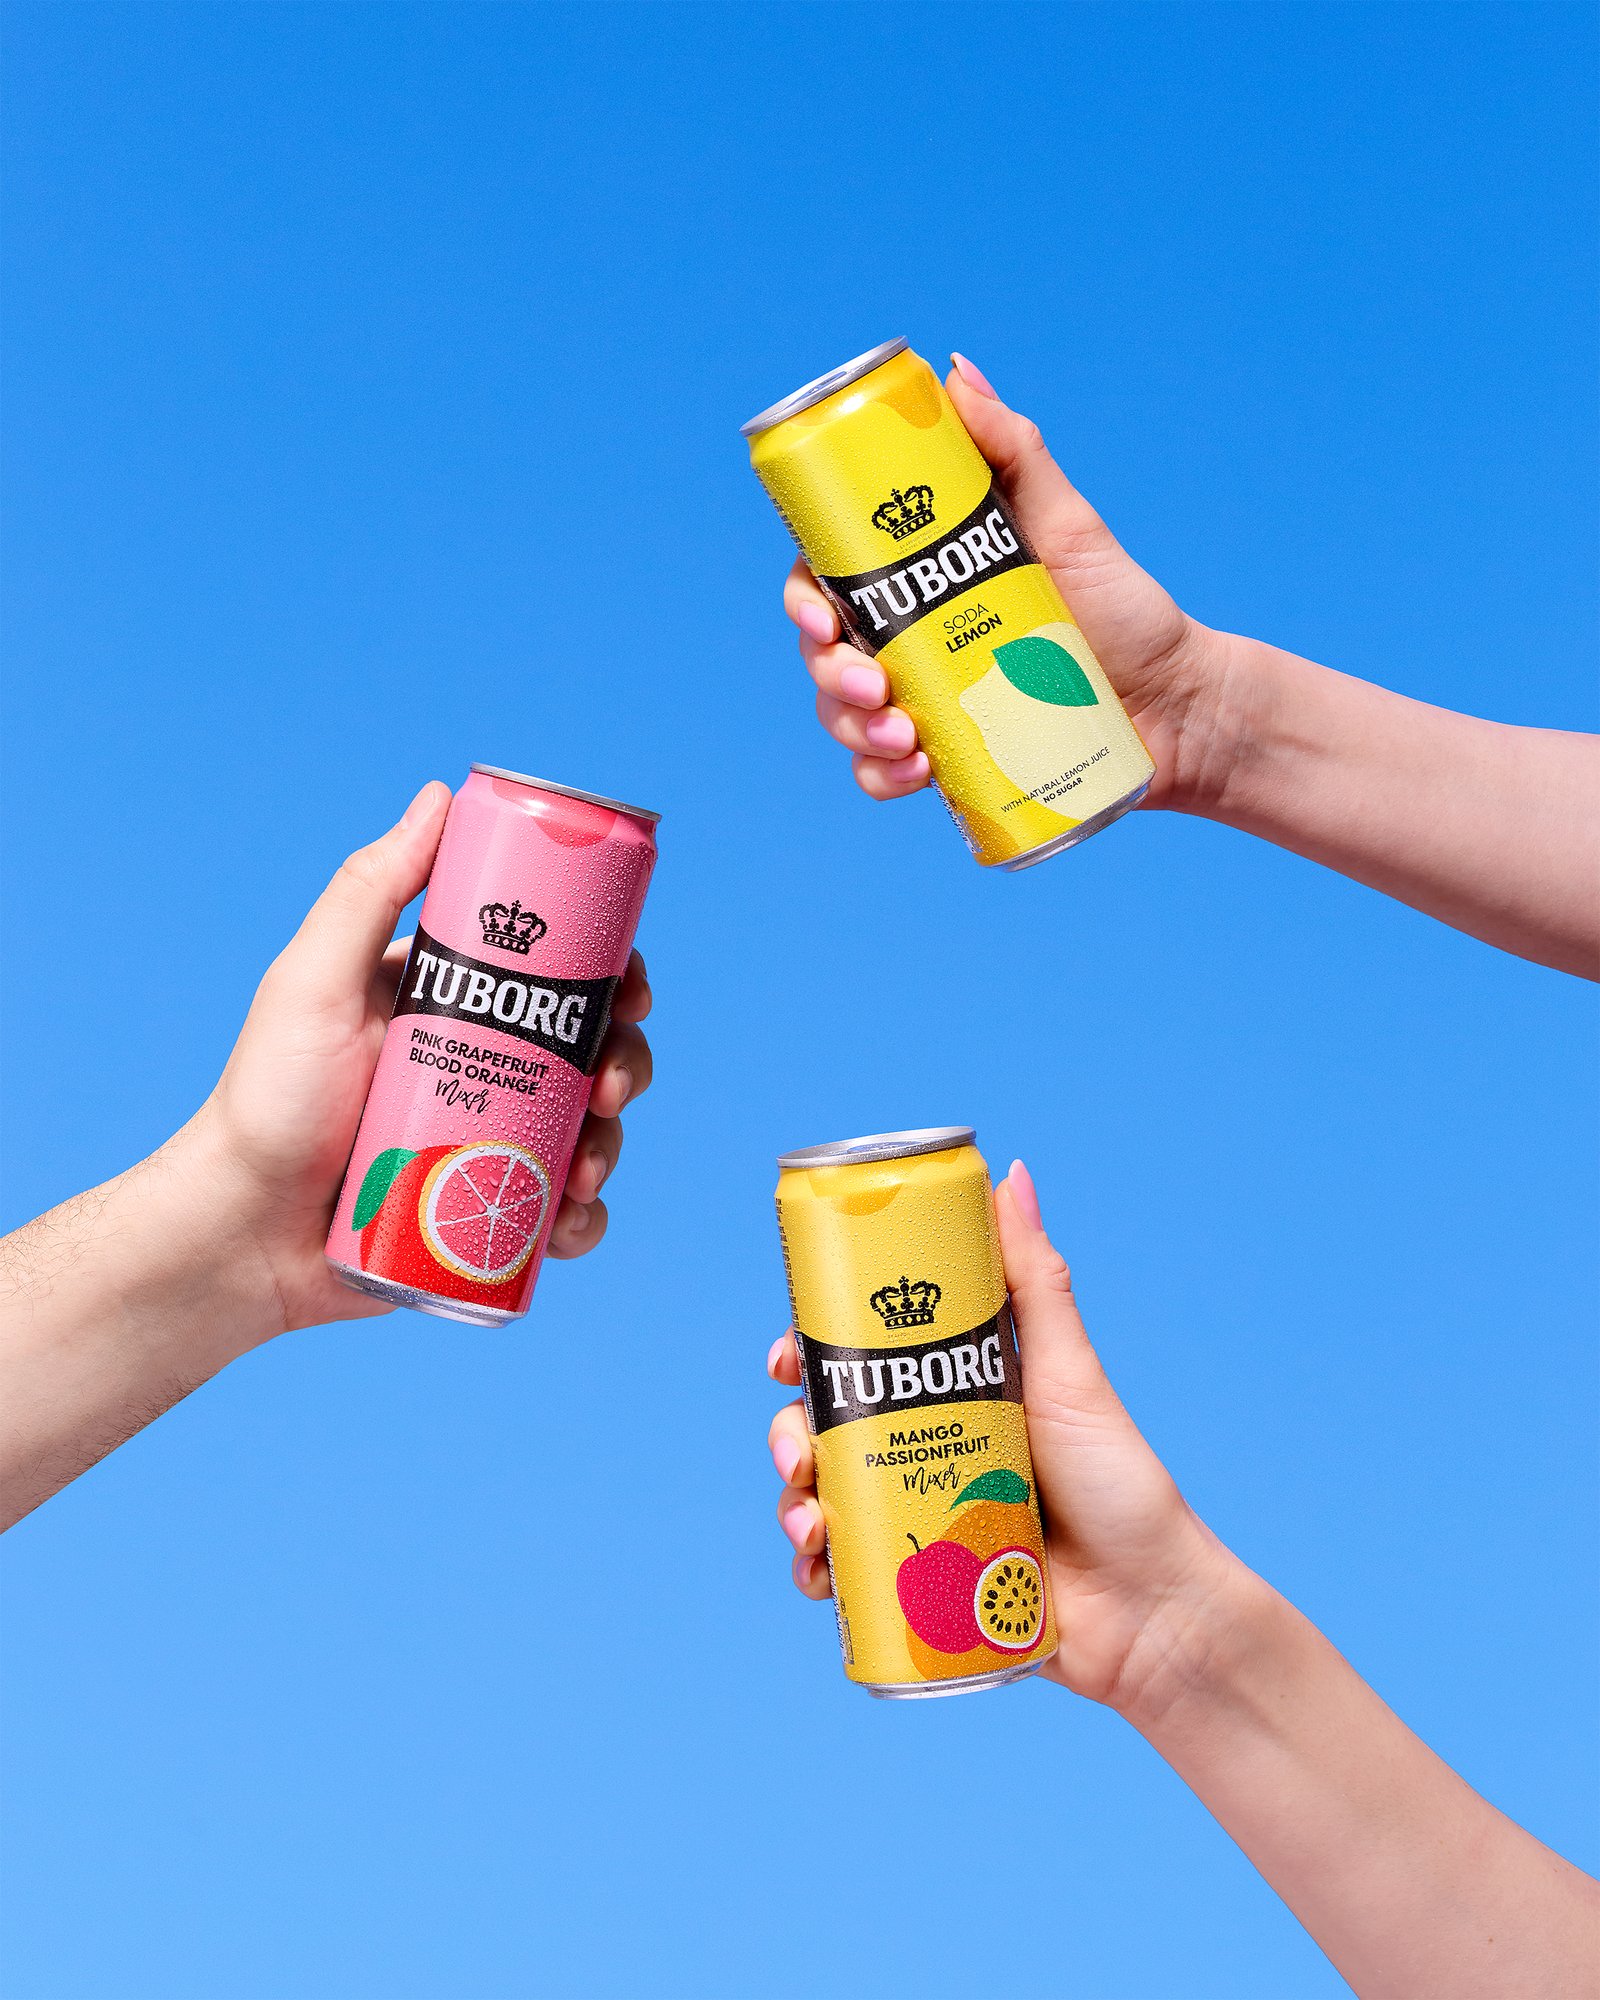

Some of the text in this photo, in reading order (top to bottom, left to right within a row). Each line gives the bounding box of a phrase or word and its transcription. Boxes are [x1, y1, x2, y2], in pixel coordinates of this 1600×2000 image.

[850, 508, 1019, 631] TUBORG
[943, 603, 989, 634] SODA
[945, 613, 1003, 653] LEMON
[1000, 746, 1110, 812] WITH NATURAL LEMON JUICE
[1042, 777, 1083, 803] NO SUGAR
[411, 950, 588, 1044] TUBORG
[409, 1047, 540, 1096] BLOOD ORANGE
[410, 1028, 549, 1079] PINK GRAPEFRUIT
[821, 1334, 1005, 1409] TUBORG
[865, 1435, 990, 1468] PASSIONFRUIT
[889, 1423, 964, 1447] MANGO
